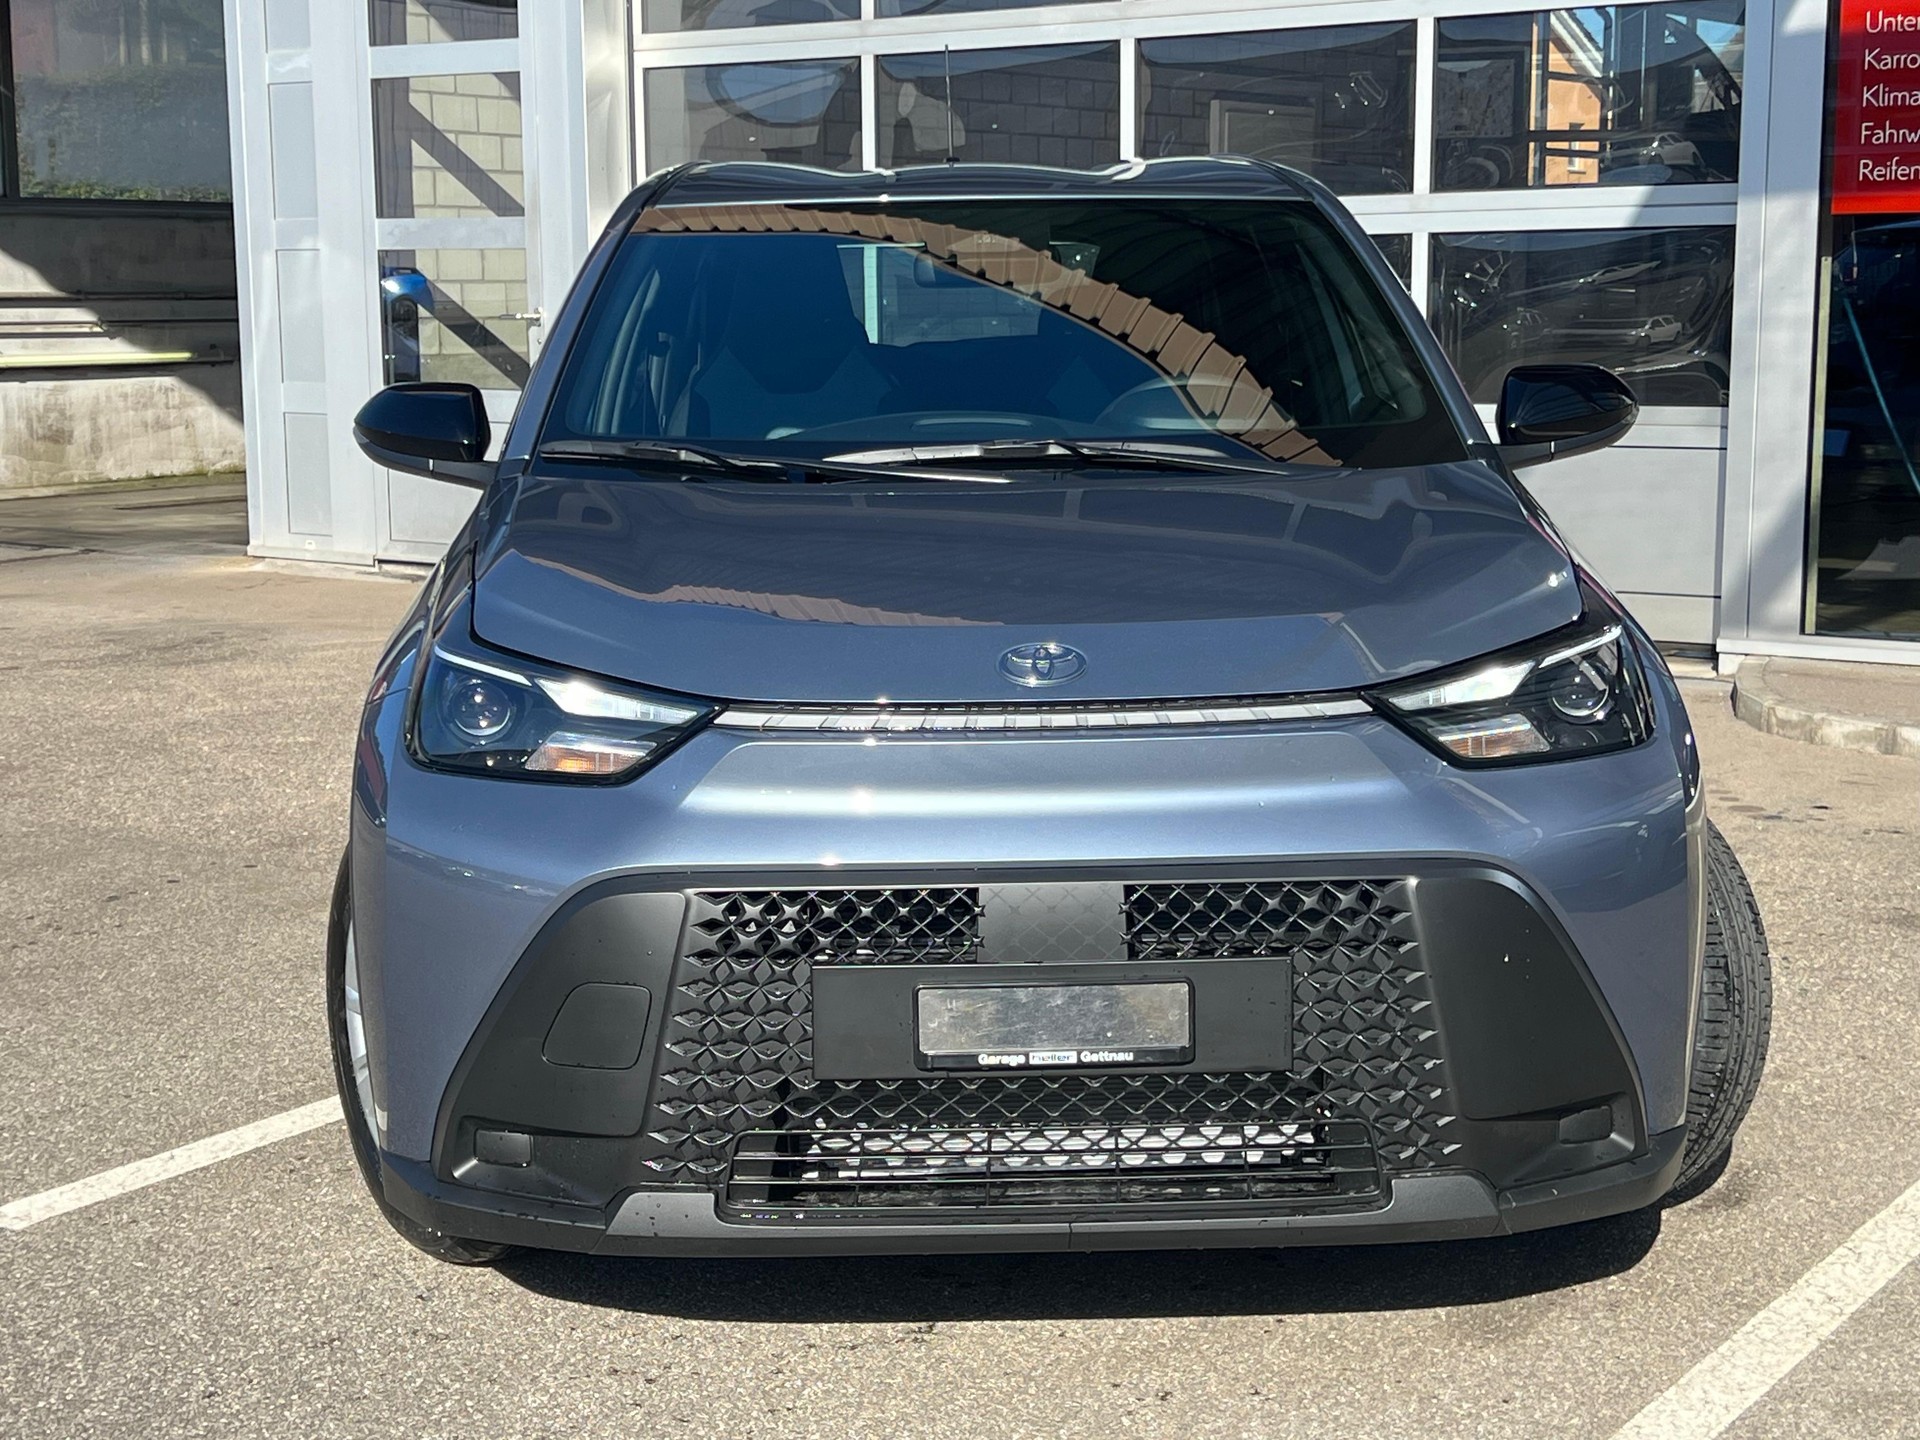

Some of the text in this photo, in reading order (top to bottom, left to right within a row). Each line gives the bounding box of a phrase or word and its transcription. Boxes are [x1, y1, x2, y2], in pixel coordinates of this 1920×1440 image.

[1864, 47, 1920, 70] Karro
[1862, 83, 1920, 107] Klima
[1861, 119, 1920, 145] Fahrw
[1858, 156, 1920, 181] Reifen
[978, 1053, 1026, 1066] Garage
[1080, 1050, 1134, 1062] Gettnau
